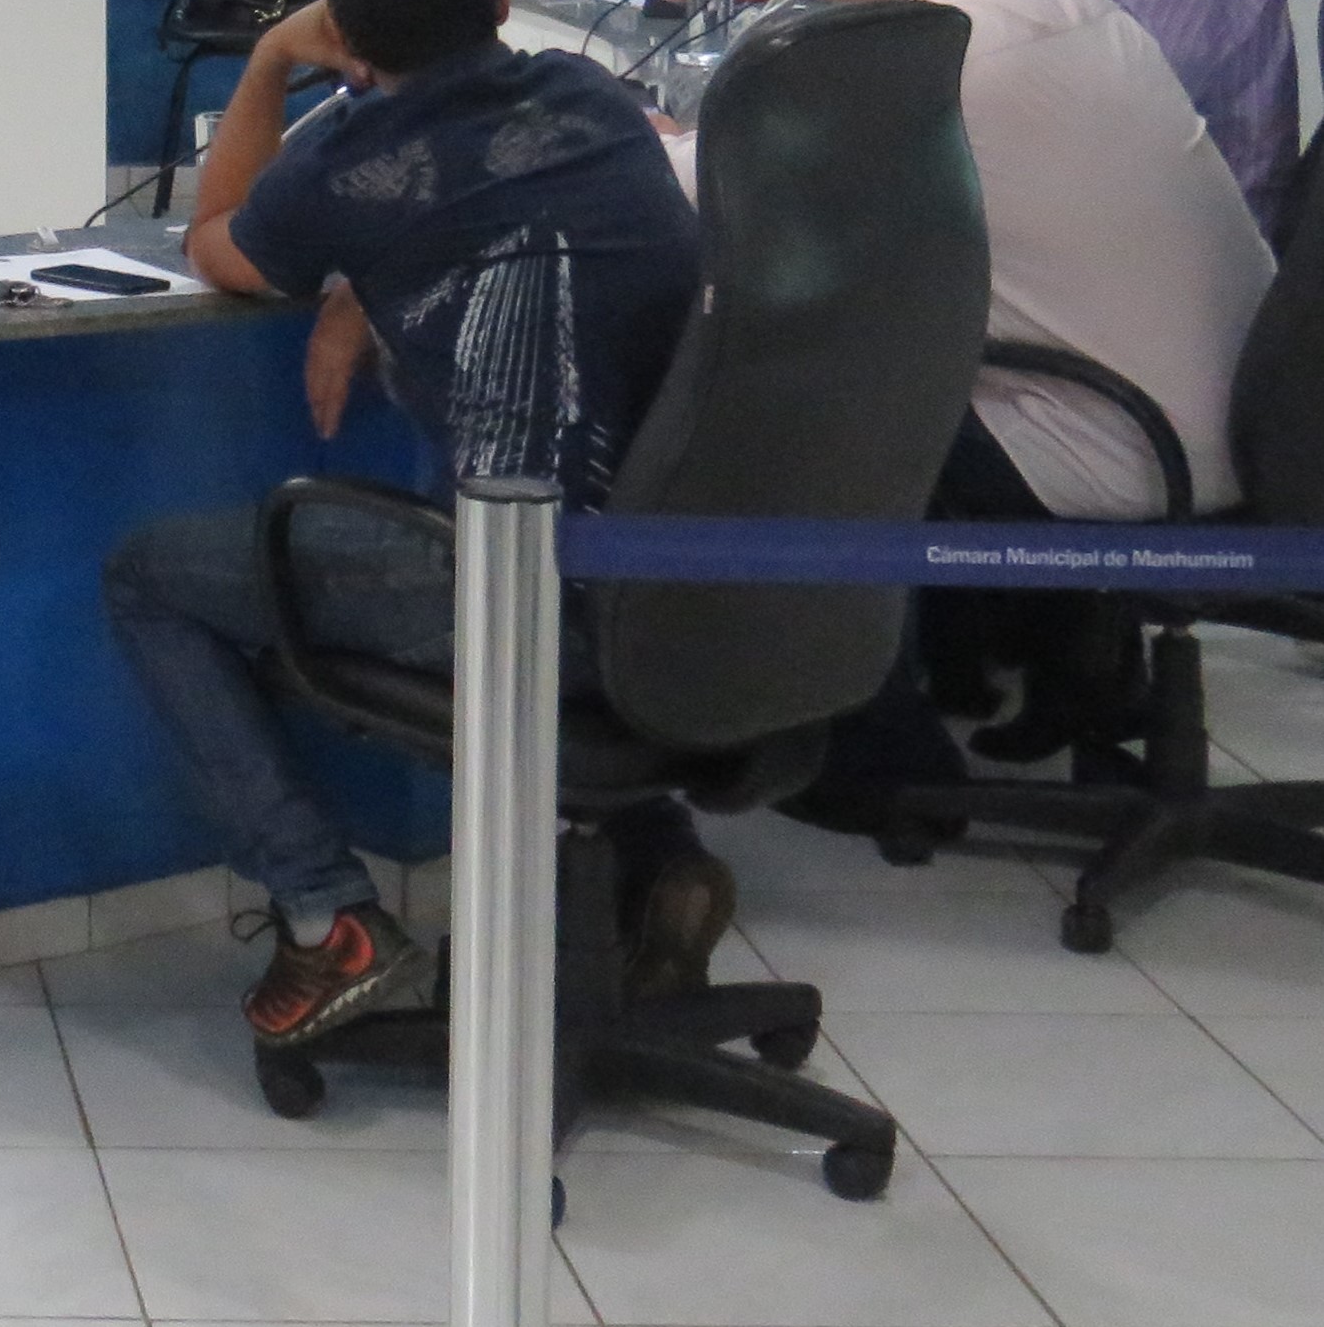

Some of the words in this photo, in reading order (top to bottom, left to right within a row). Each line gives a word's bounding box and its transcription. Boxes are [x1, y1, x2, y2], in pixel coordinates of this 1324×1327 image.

[926, 545, 1002, 564] Câmara
[1006, 547, 1099, 569] Municipal
[1104, 550, 1129, 567] de
[1132, 549, 1253, 569] Manhumirim
